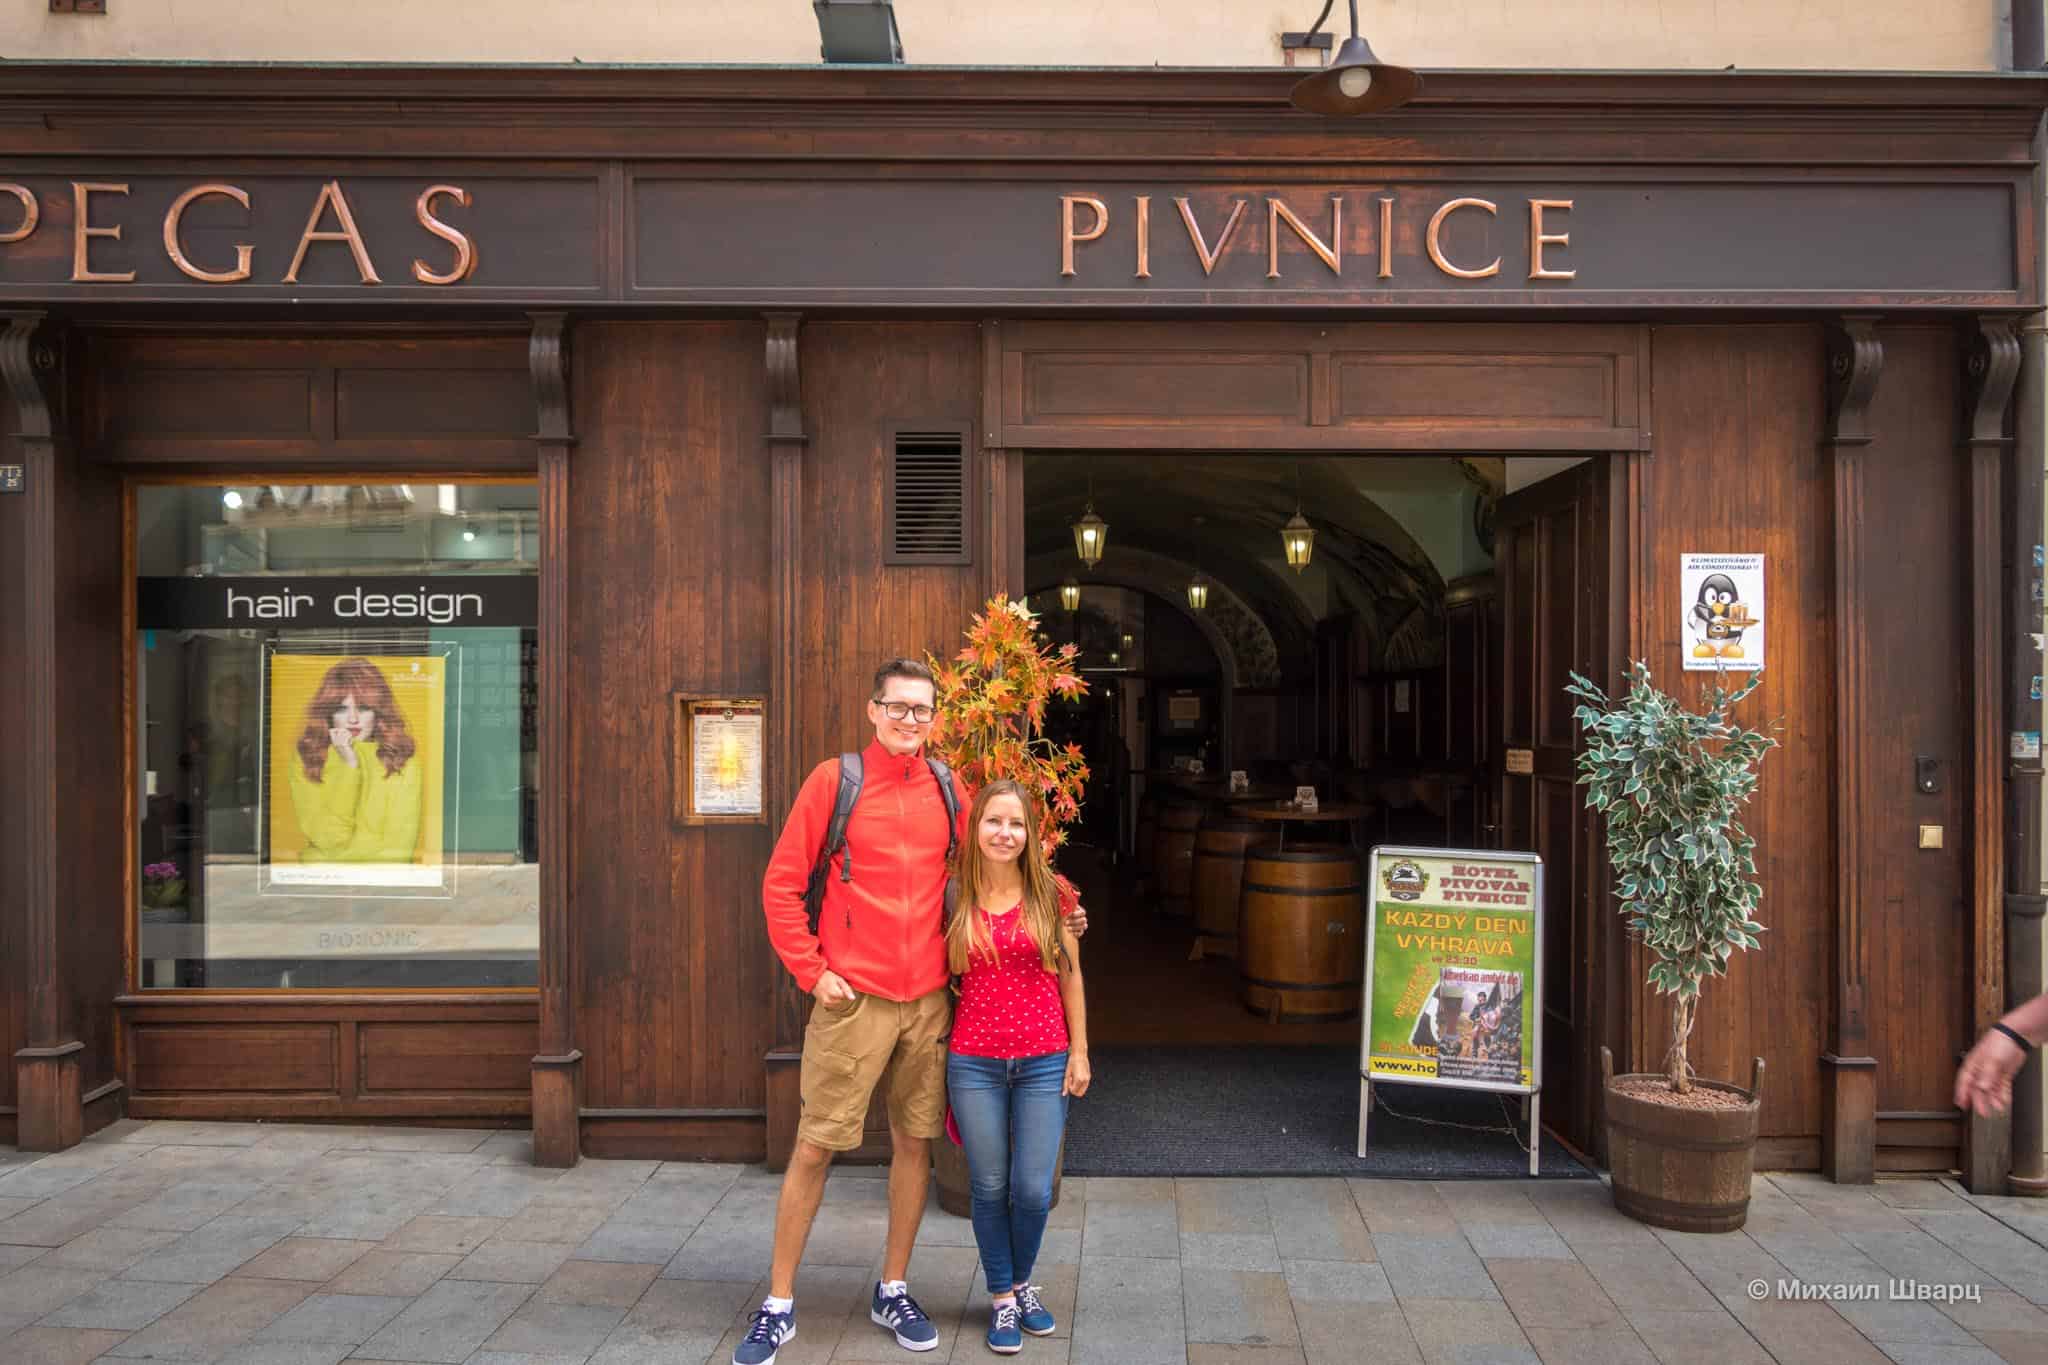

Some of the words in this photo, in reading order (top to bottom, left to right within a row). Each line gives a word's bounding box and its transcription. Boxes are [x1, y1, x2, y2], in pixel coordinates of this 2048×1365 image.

[1060, 195, 1577, 279] PIVNICE
[227, 587, 314, 618] hair
[334, 586, 482, 623] design
[1452, 864, 1518, 880] HOTEL
[1440, 877, 1530, 893] PIVOVAR
[1443, 890, 1527, 905] PIVNICE
[1475, 916, 1527, 935] DEN
